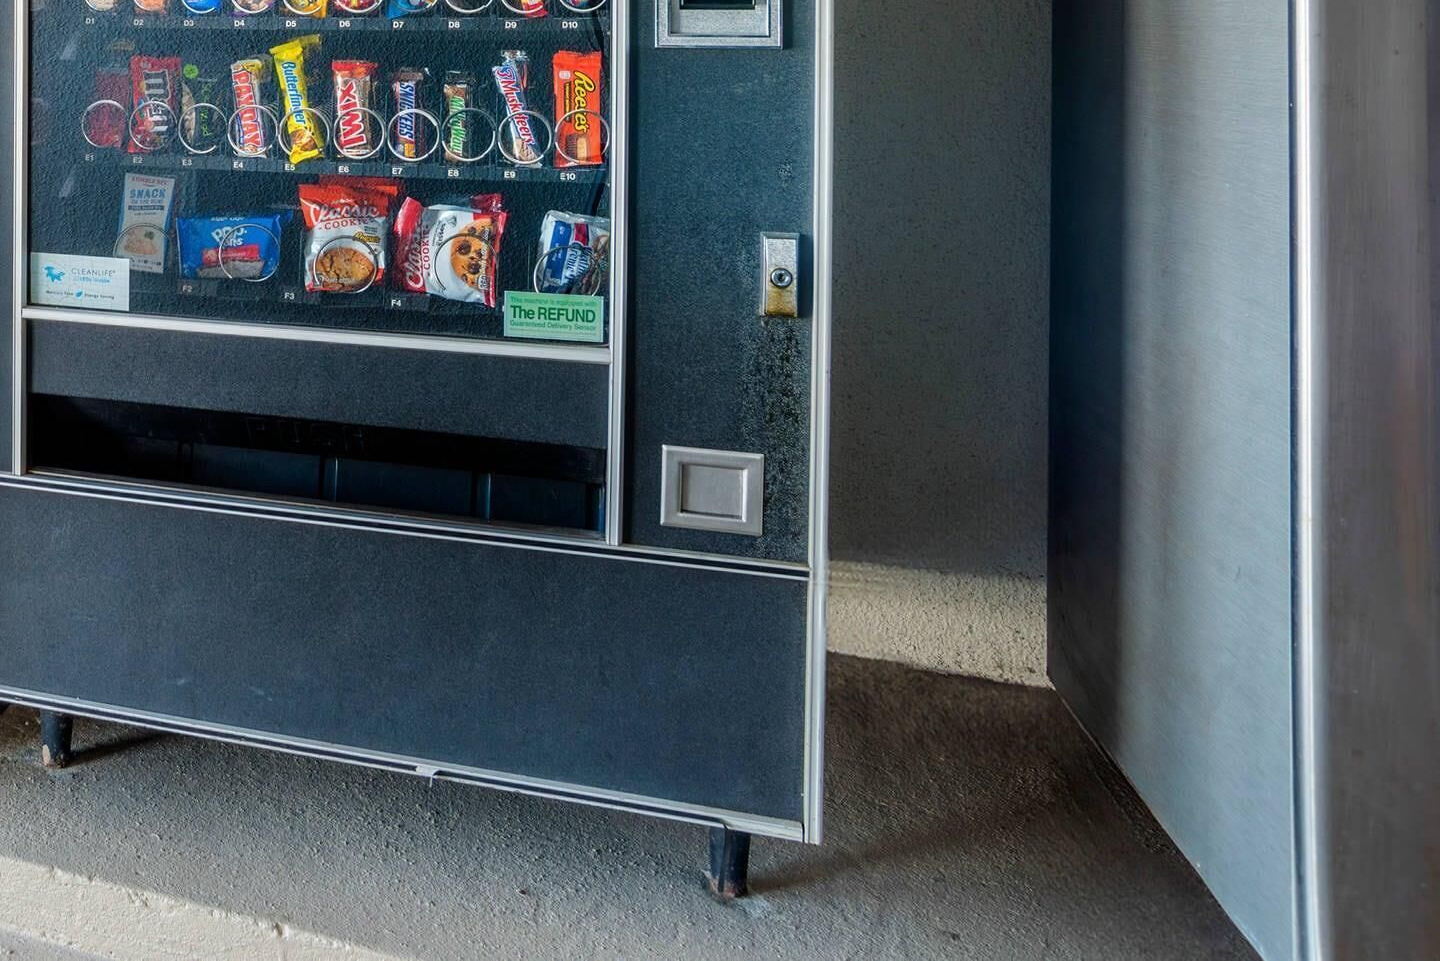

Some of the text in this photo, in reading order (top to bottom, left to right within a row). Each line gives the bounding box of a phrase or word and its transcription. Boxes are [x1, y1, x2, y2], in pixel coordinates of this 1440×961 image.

[286, 20, 297, 28] D5
[392, 21, 404, 29] D7
[448, 21, 460, 29] D8
[504, 21, 516, 29] D9
[562, 21, 578, 29] D10
[496, 66, 513, 79] 3
[574, 70, 596, 133] Reese's
[337, 81, 367, 149] TWIX
[133, 156, 143, 164] E2
[504, 171, 516, 179] E9
[560, 172, 576, 181] E10
[130, 188, 166, 199] SNACK
[422, 228, 430, 270] COOKIE
[284, 292, 295, 300] F3
[391, 300, 401, 308] F4
[510, 305, 596, 323] The REFUND
[510, 320, 546, 328] Guaranteed
[548, 321, 573, 331] Delivery
